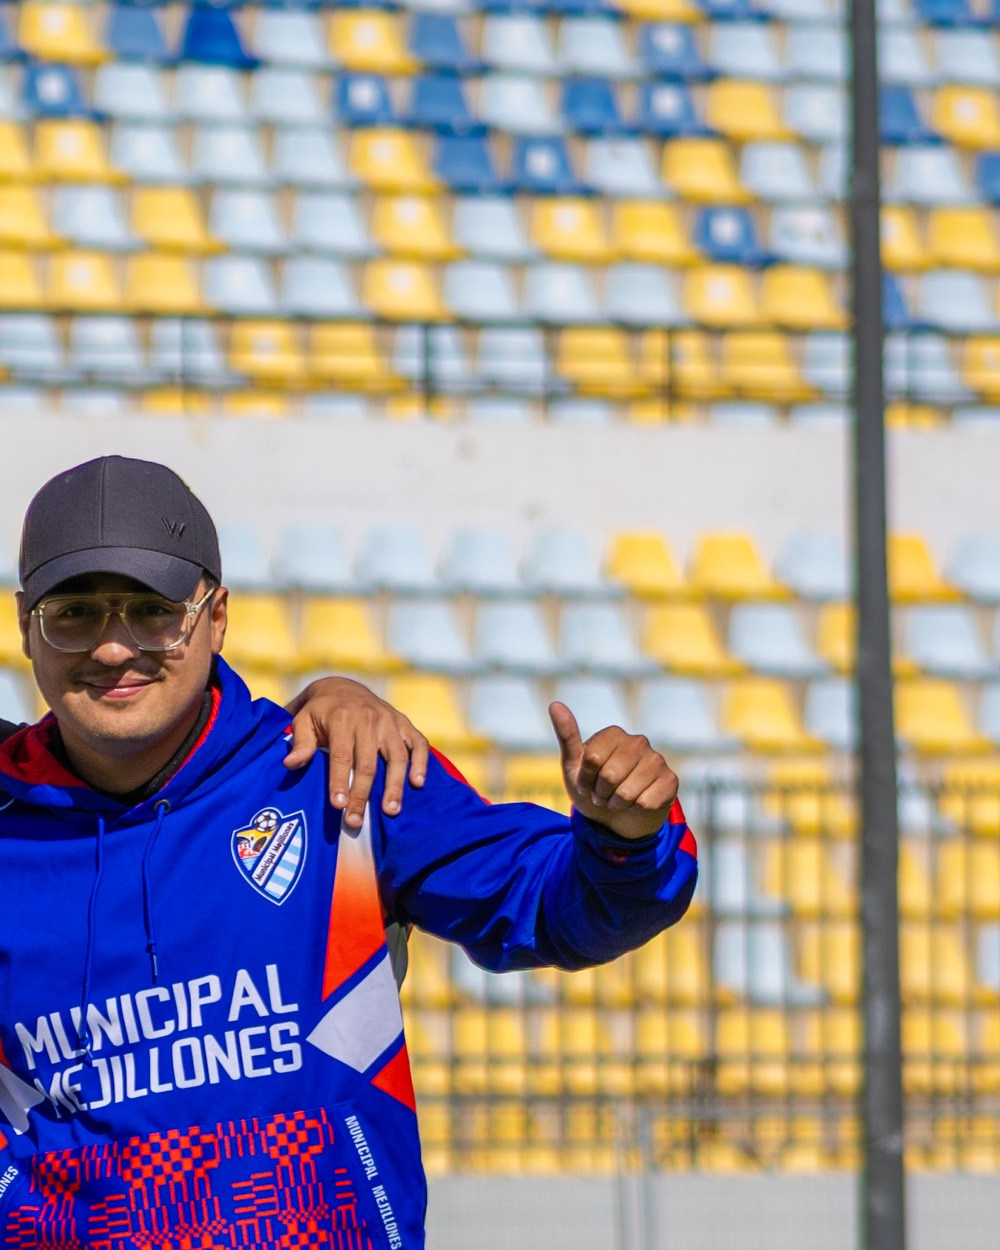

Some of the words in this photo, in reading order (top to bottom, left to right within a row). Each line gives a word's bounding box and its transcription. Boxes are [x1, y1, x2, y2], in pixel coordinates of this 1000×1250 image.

[254, 853, 277, 881] Municipal
[272, 822, 295, 854] Mejillones
[14, 963, 299, 1070] MUNICIPAL
[33, 1021, 303, 1119] MEJILLONES
[344, 1115, 379, 1181] MUNICIPAL
[371, 1184, 403, 1250] MEJILLONES
